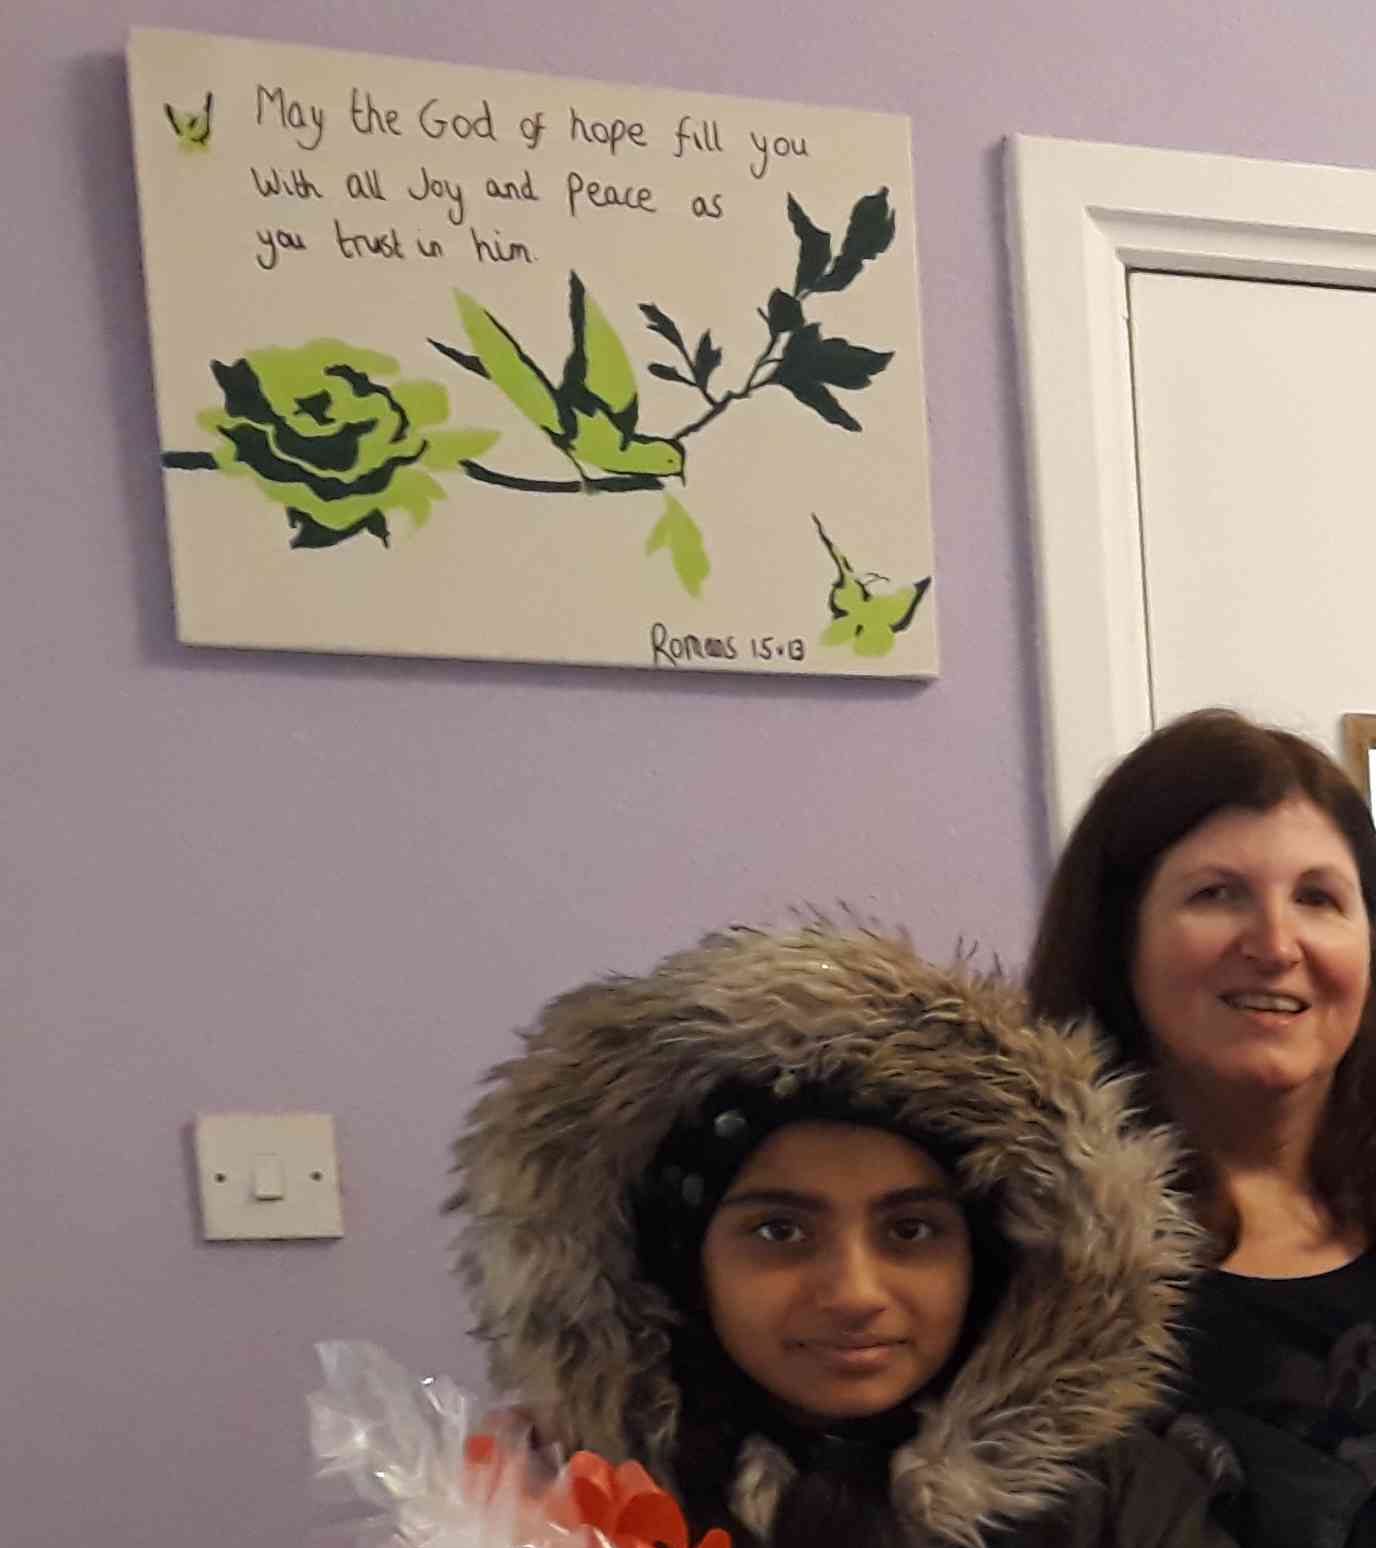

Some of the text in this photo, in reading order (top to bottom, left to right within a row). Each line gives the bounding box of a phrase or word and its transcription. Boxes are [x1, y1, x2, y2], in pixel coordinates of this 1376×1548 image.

[257, 84, 809, 179] May the God of hope fill you
[250, 166, 324, 200] With
[346, 168, 386, 201] all
[408, 166, 464, 226] Joy
[485, 169, 540, 202] and
[692, 194, 723, 218] as
[256, 228, 307, 271] you
[333, 217, 404, 259] trust
[416, 227, 444, 258] in
